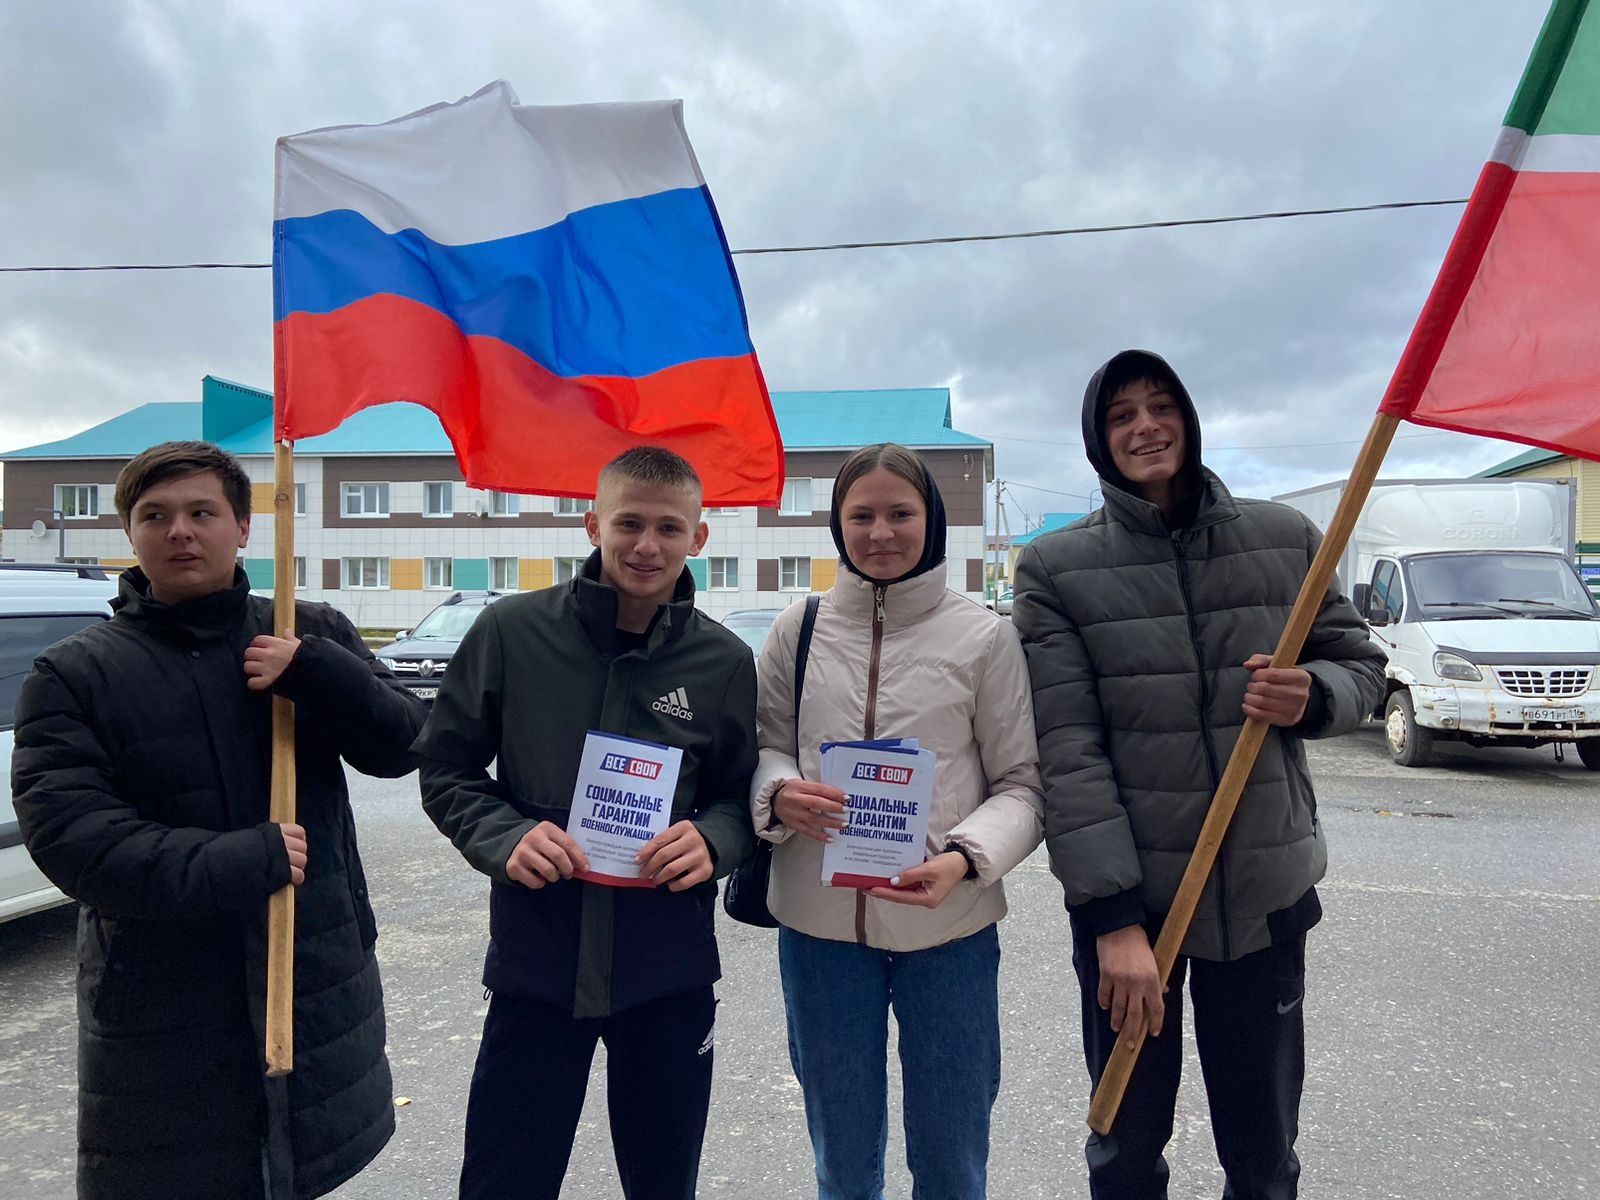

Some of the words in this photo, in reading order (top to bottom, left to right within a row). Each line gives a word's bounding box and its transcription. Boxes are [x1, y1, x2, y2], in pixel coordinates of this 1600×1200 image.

[652, 701, 694, 721] adidas
[1528, 709, 1566, 720] В691РТ
[605, 754, 627, 772] ВСЕ
[629, 759, 658, 778] СВОИ
[856, 764, 877, 779] ВСЕ
[880, 767, 909, 784] СВОИ
[585, 784, 664, 812] СОЦИАЛЬНЫЕ
[844, 794, 919, 816] ОЦИАЛЬНЫЕ
[592, 803, 652, 828] ГАРАНТИИ
[849, 811, 907, 831] ГАРАНТИИ
[581, 818, 656, 841] ВОЕННОСЛУЖАЩИХ
